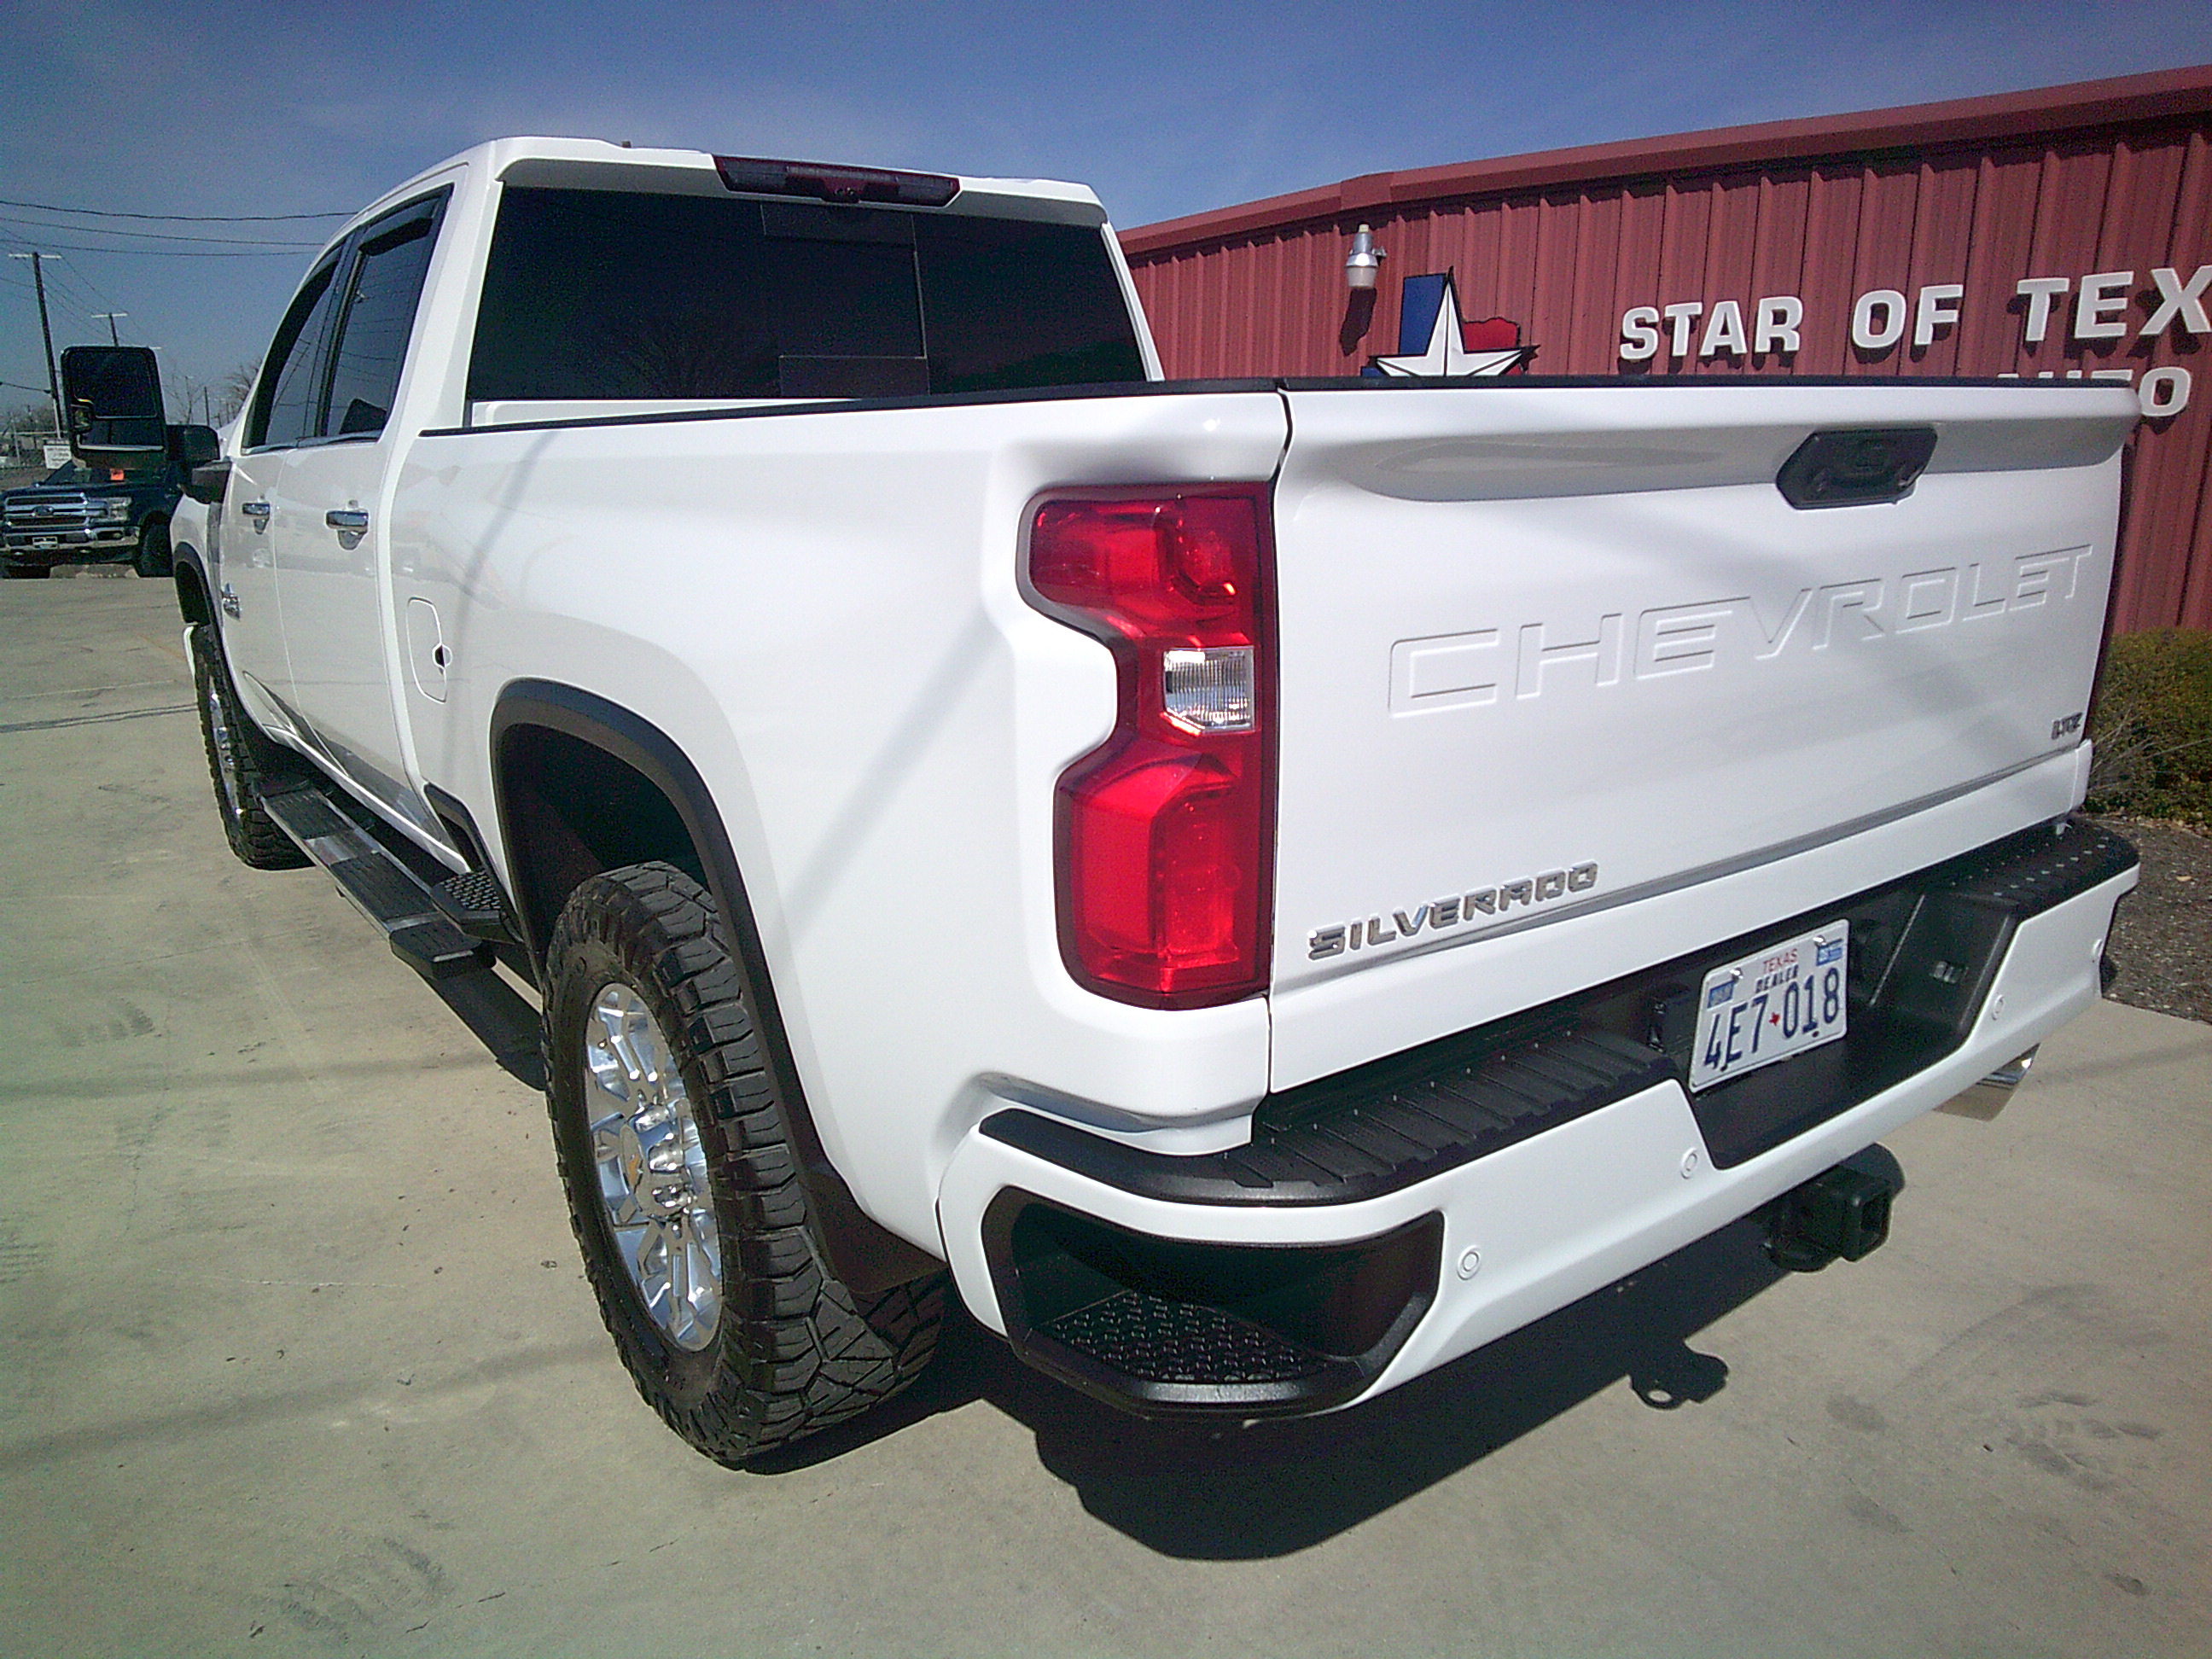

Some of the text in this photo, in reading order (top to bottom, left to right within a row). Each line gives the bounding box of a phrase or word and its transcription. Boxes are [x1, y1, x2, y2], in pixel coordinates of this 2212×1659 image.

[1620, 265, 2212, 361] STAR OF TEX
[1388, 544, 2093, 718] CHEVROLET
[2051, 712, 2083, 740] LTZ
[1307, 860, 1598, 961] SILVERADO
[1763, 948, 1798, 974] TEXAS
